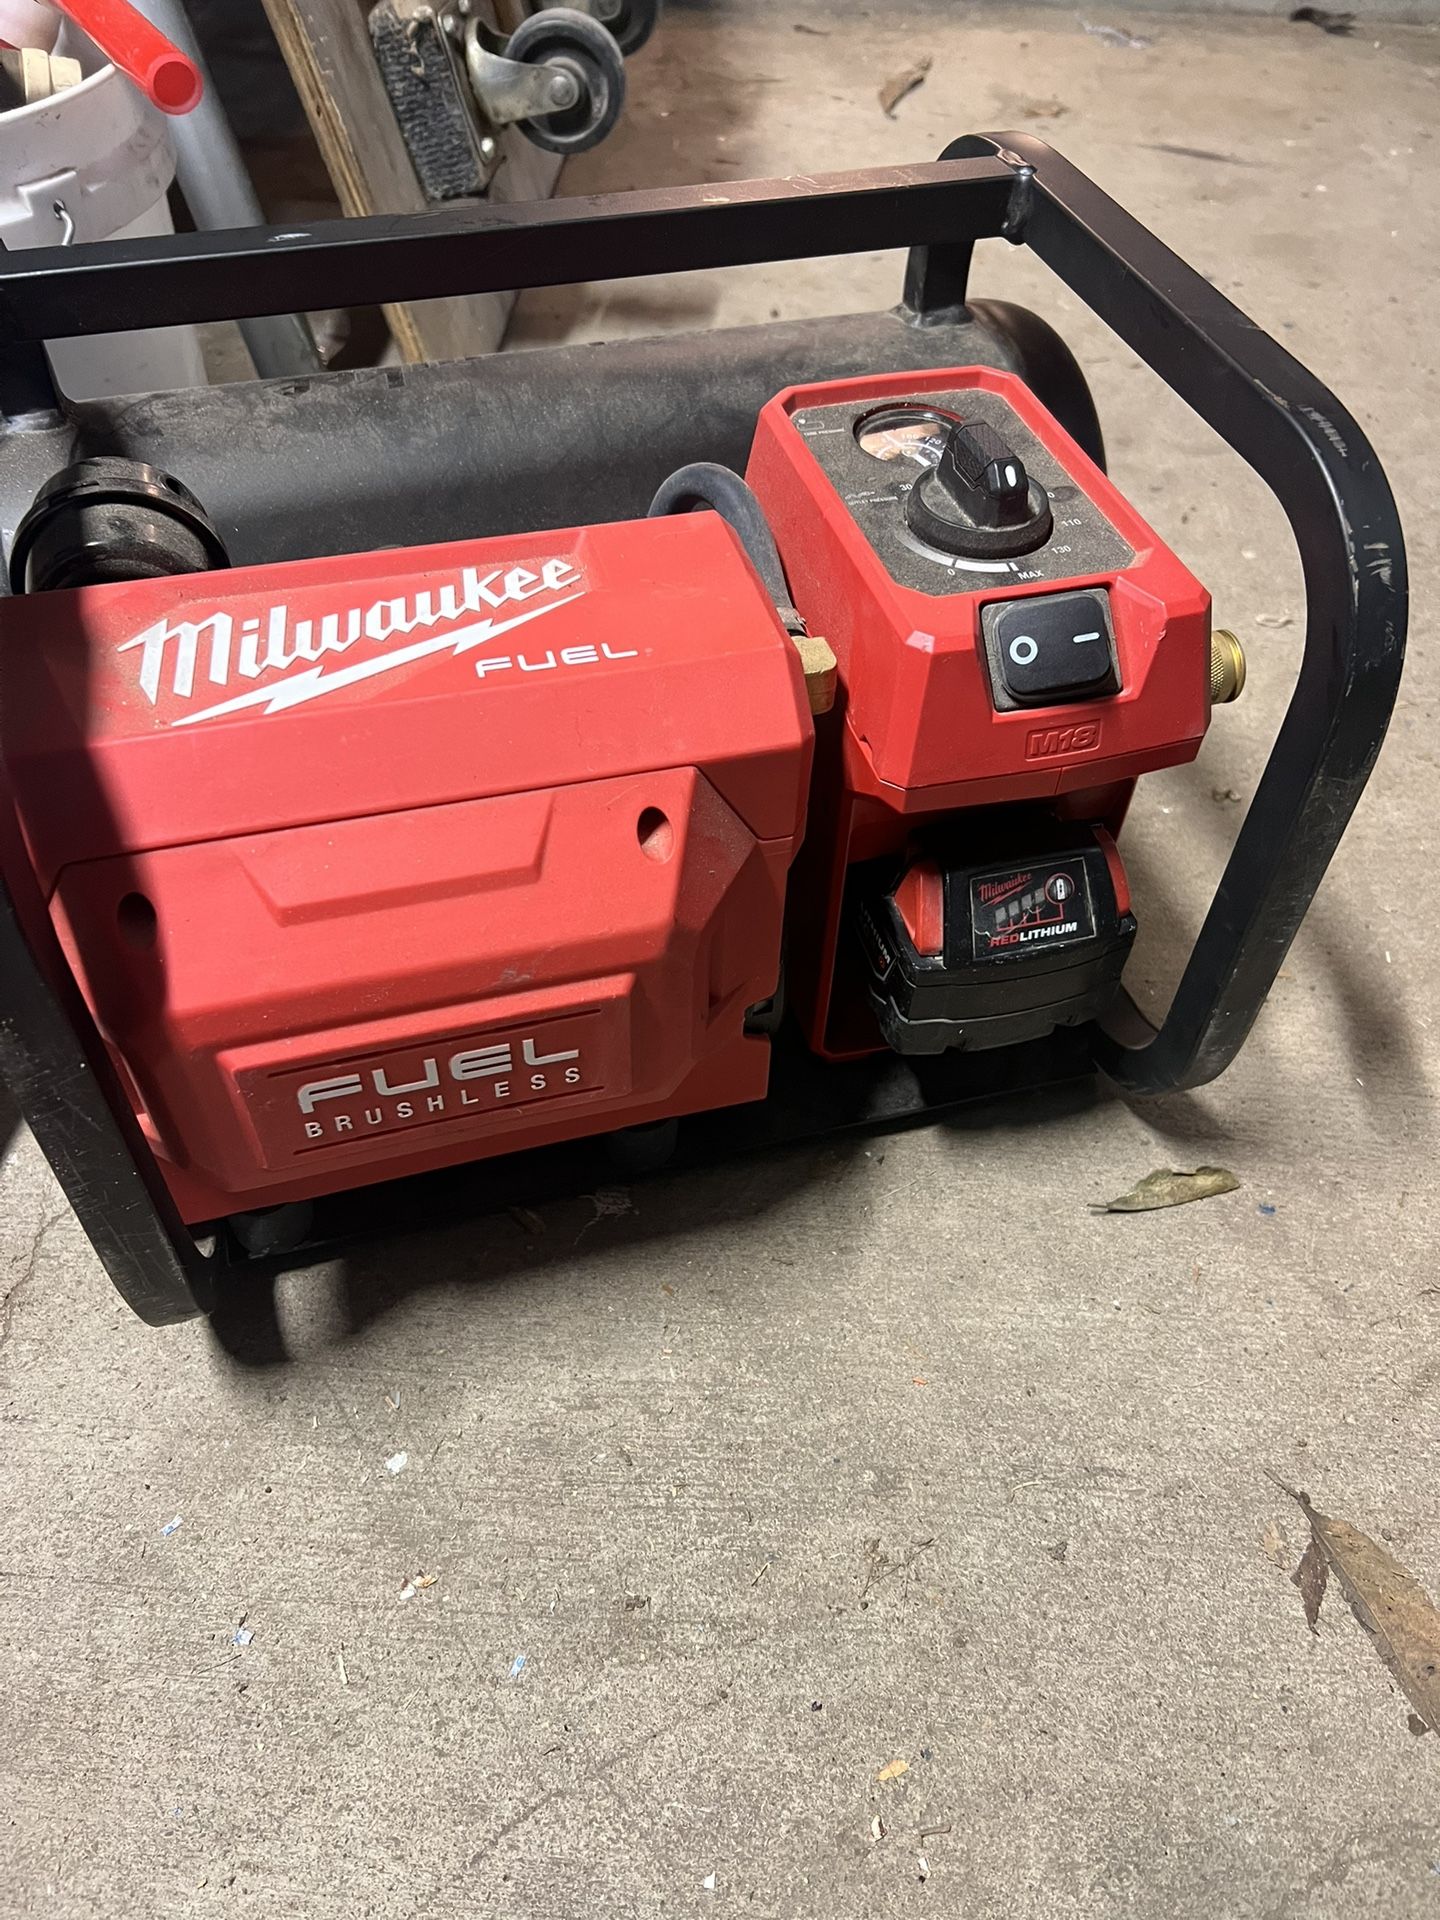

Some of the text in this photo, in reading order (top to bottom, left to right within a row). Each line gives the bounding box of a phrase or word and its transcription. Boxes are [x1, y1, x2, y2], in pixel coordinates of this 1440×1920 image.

[924, 436, 942, 445] 120
[899, 483, 913, 491] 30
[1047, 491, 1056, 499] 0
[1061, 518, 1082, 527] 110
[1051, 545, 1072, 555] 130
[947, 568, 956, 576] 0
[1017, 569, 1045, 580] MAX
[117, 558, 582, 706] Milwaukee
[475, 641, 639, 678] FUEL
[1030, 725, 1097, 756] M18
[978, 872, 1033, 901] Milwaukee
[988, 921, 1078, 948] REDLITHIUM
[297, 1038, 580, 1114] FUEL
[304, 1067, 581, 1138] BRUSHLESS
